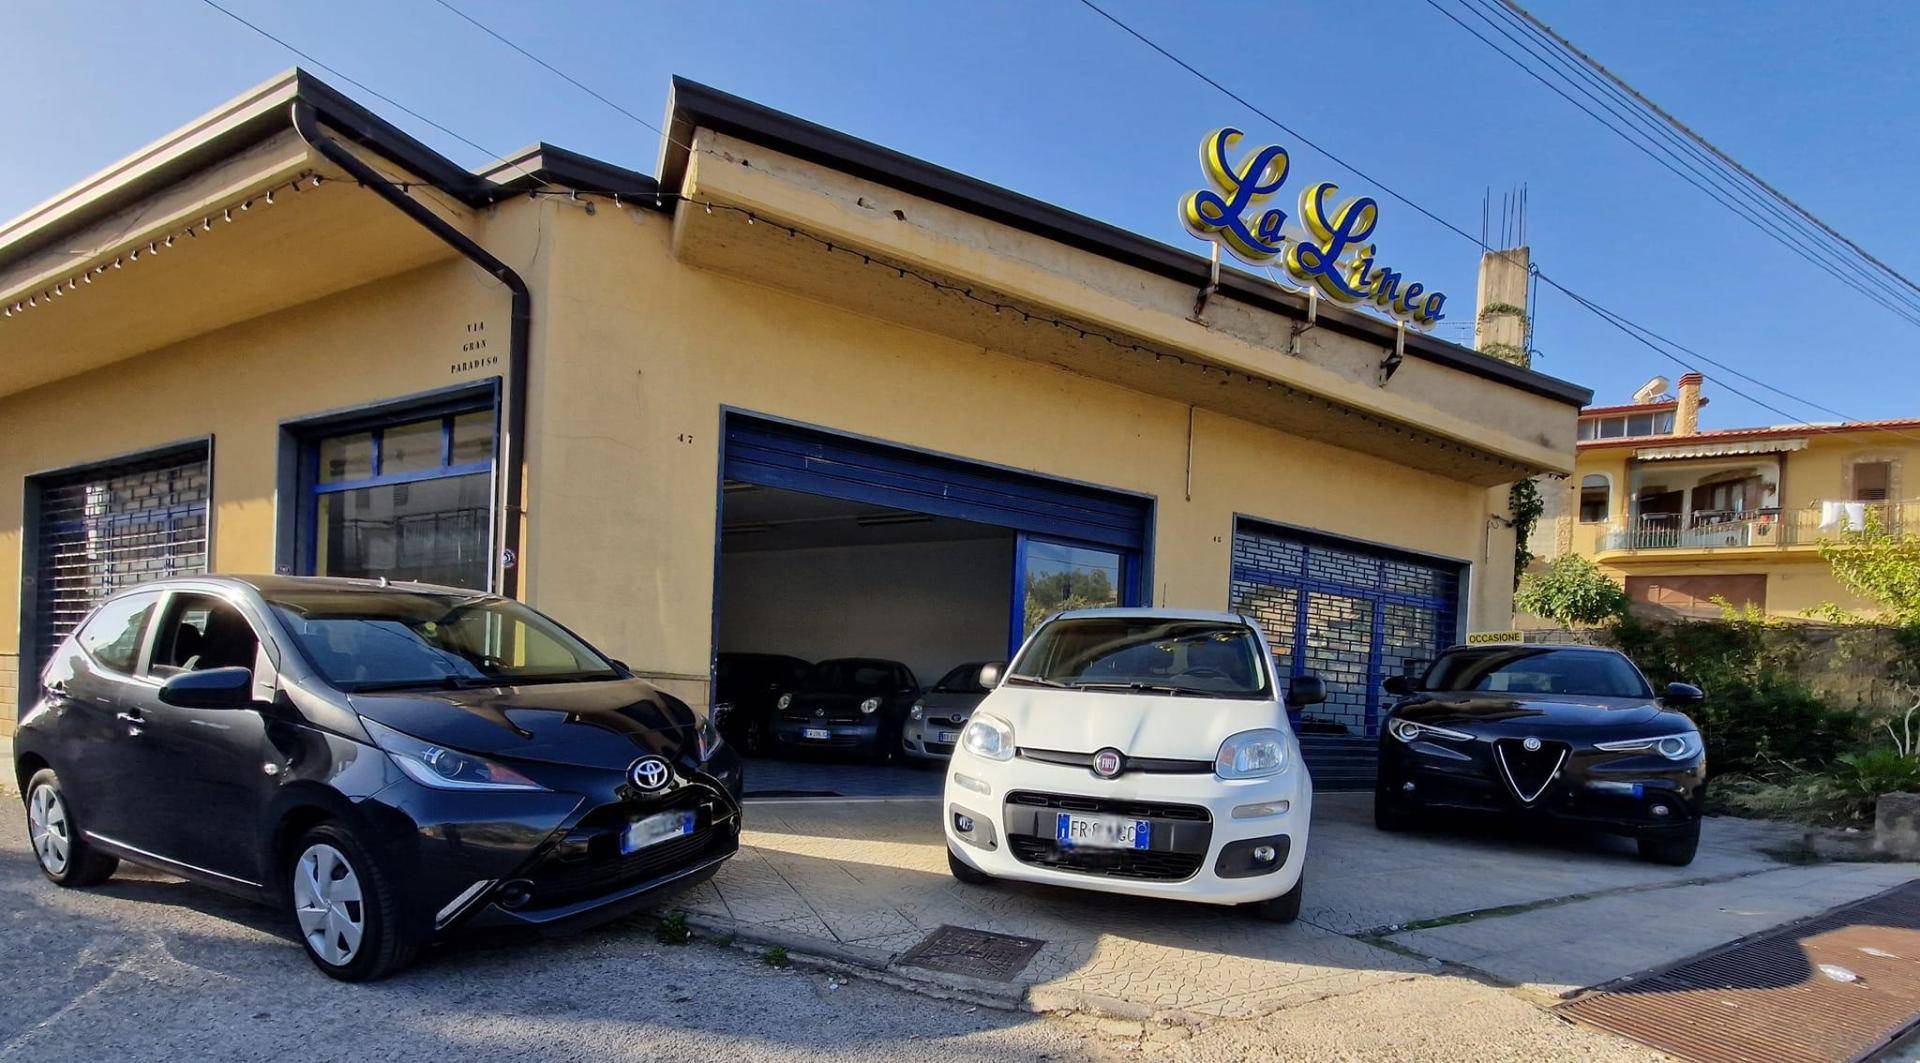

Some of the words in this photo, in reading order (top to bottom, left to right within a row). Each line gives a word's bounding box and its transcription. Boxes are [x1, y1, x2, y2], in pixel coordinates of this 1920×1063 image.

[1180, 127, 1290, 254] La
[1291, 181, 1448, 321] Linea
[467, 321, 484, 332] VIA
[463, 340, 486, 352] GRAN
[451, 356, 498, 374] PARADISO
[677, 433, 694, 444] 47
[1469, 632, 1520, 643] OCCASIONE
[1101, 758, 1116, 769] FIAT
